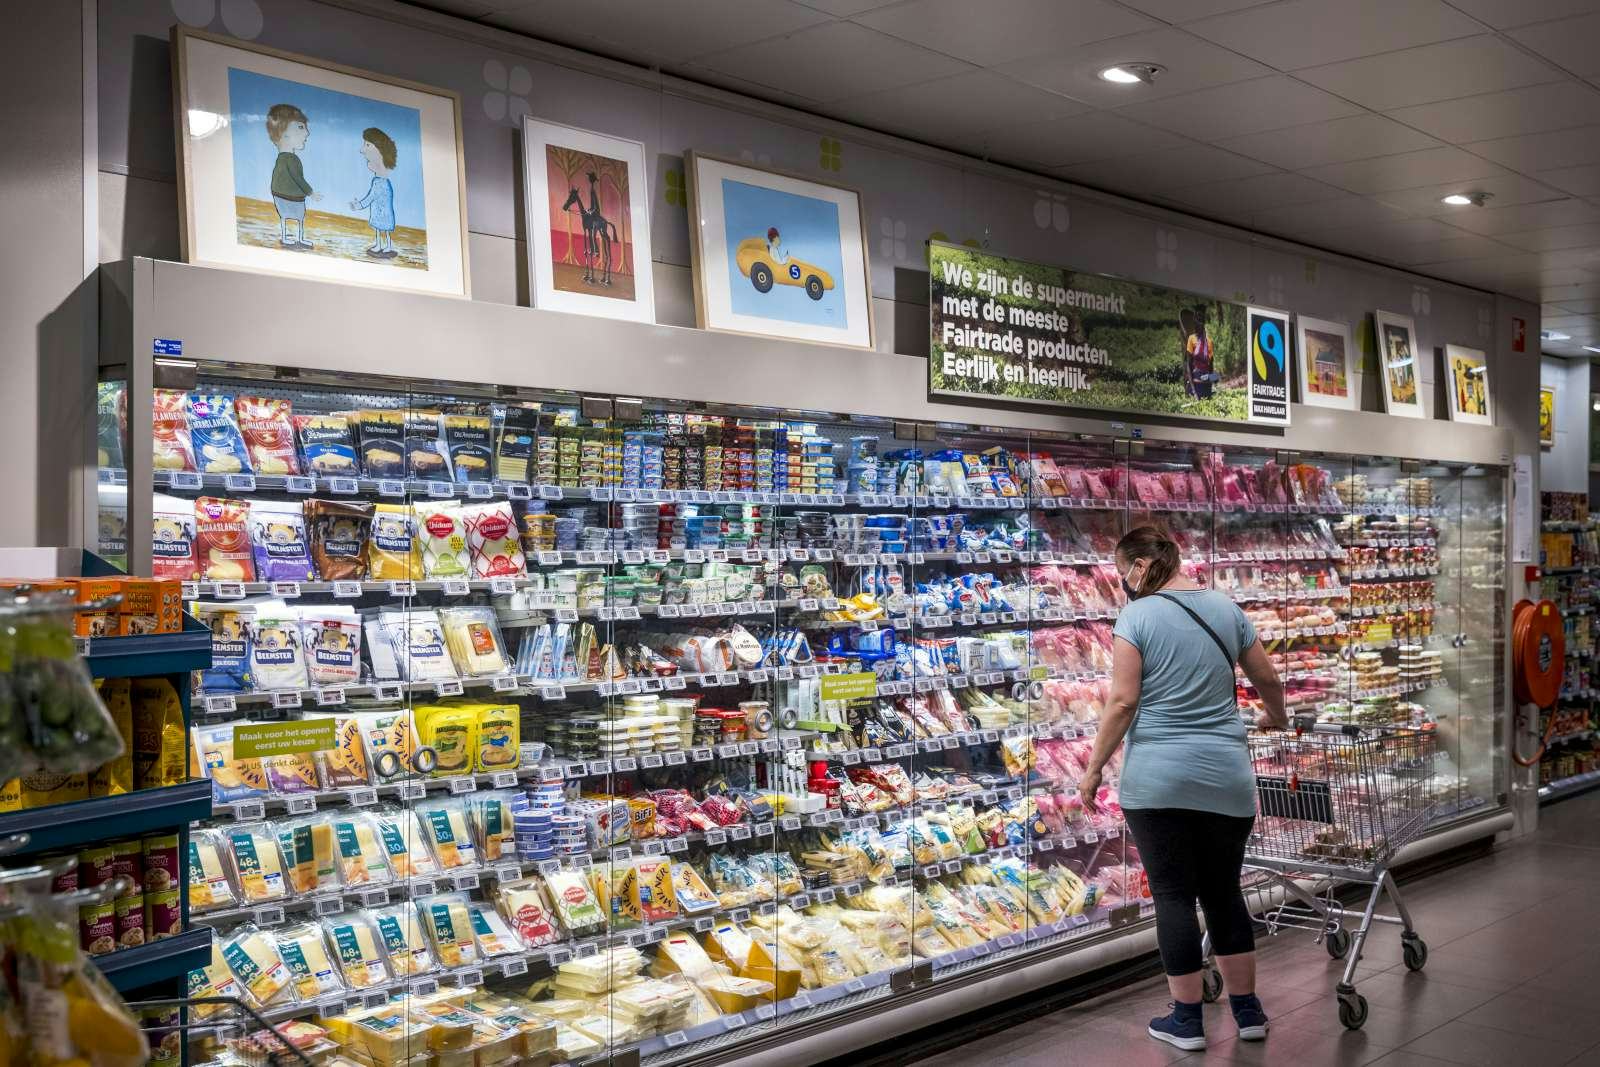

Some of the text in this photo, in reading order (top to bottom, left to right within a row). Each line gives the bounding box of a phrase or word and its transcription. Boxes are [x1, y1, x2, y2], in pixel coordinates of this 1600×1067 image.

[791, 266, 799, 278] 5
[942, 261, 1126, 315] We zijn de supermarkt
[942, 296, 1069, 333] met de meeste
[942, 321, 1113, 367] Fairtrade producten.
[942, 352, 1092, 393] Eerlijk en heerlijk.
[1253, 384, 1286, 398] FAIRTRADE
[1253, 404, 1286, 416] MAX HAVELAAR
[267, 544, 303, 553] BEEMSTER
[326, 542, 357, 552] BEEMSTER
[378, 538, 410, 548] BEEMSTER
[256, 652, 292, 660] BEEMSTER
[318, 652, 351, 662] BEEMSTER
[240, 732, 262, 741] Maak
[286, 729, 299, 737] het
[301, 727, 330, 737] openen
[255, 741, 277, 750] eerst
[293, 738, 316, 746] keuze
[634, 807, 653, 822] BiFi
[240, 856, 258, 868] 48+
[654, 866, 675, 908] MILNER
[342, 948, 360, 959] 48+
[238, 961, 257, 978] 48+
